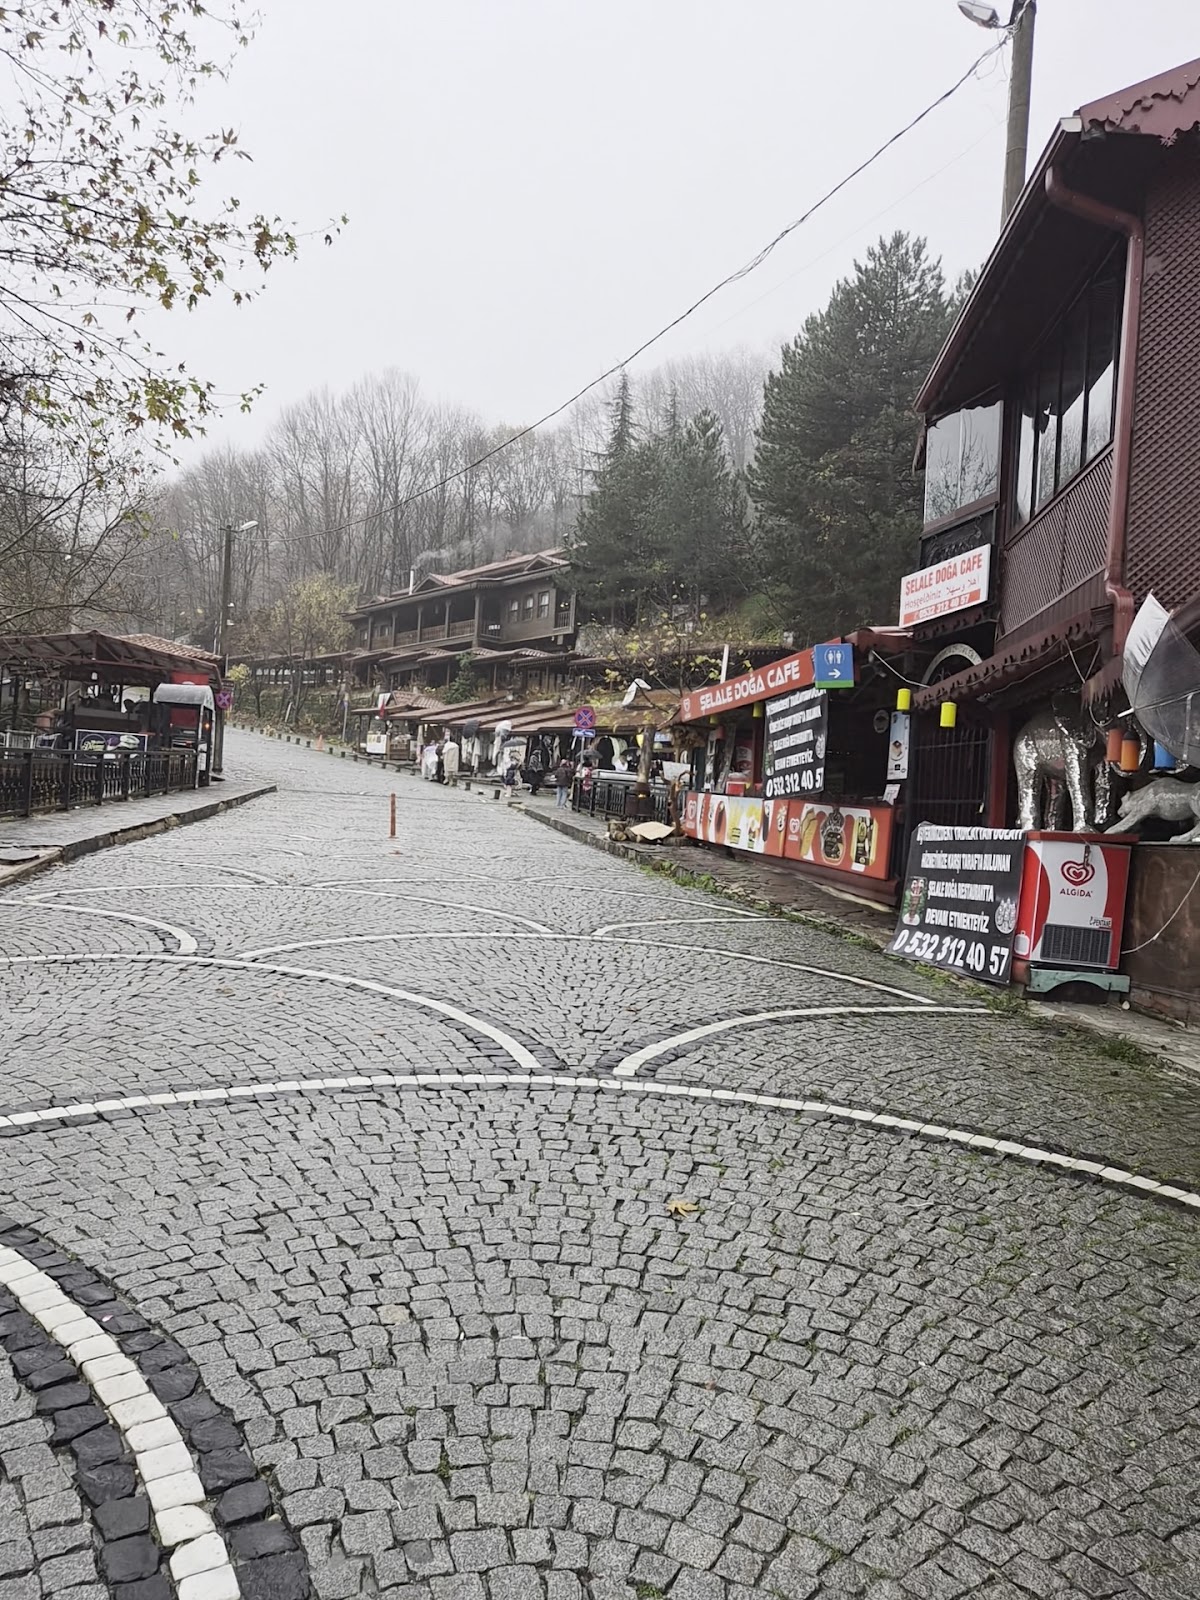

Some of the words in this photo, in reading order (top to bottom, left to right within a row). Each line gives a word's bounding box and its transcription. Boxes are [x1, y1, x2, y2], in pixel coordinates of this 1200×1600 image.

[905, 571, 933, 596] SELALE
[935, 561, 958, 585] DOĞA
[960, 553, 983, 576] CAFE
[960, 593, 970, 605] 57
[734, 673, 766, 700] DOĞA
[767, 660, 800, 688] CAFE
[766, 779, 774, 798] 0
[773, 776, 785, 796] 532
[785, 772, 800, 793] 312
[801, 769, 814, 790] 40
[815, 767, 825, 789] 57
[924, 907, 949, 927] DEVAM
[892, 929, 910, 951] 0
[903, 931, 940, 960] 532
[936, 936, 967, 968] 312
[966, 941, 986, 972] 40
[989, 945, 1010, 977] 57
